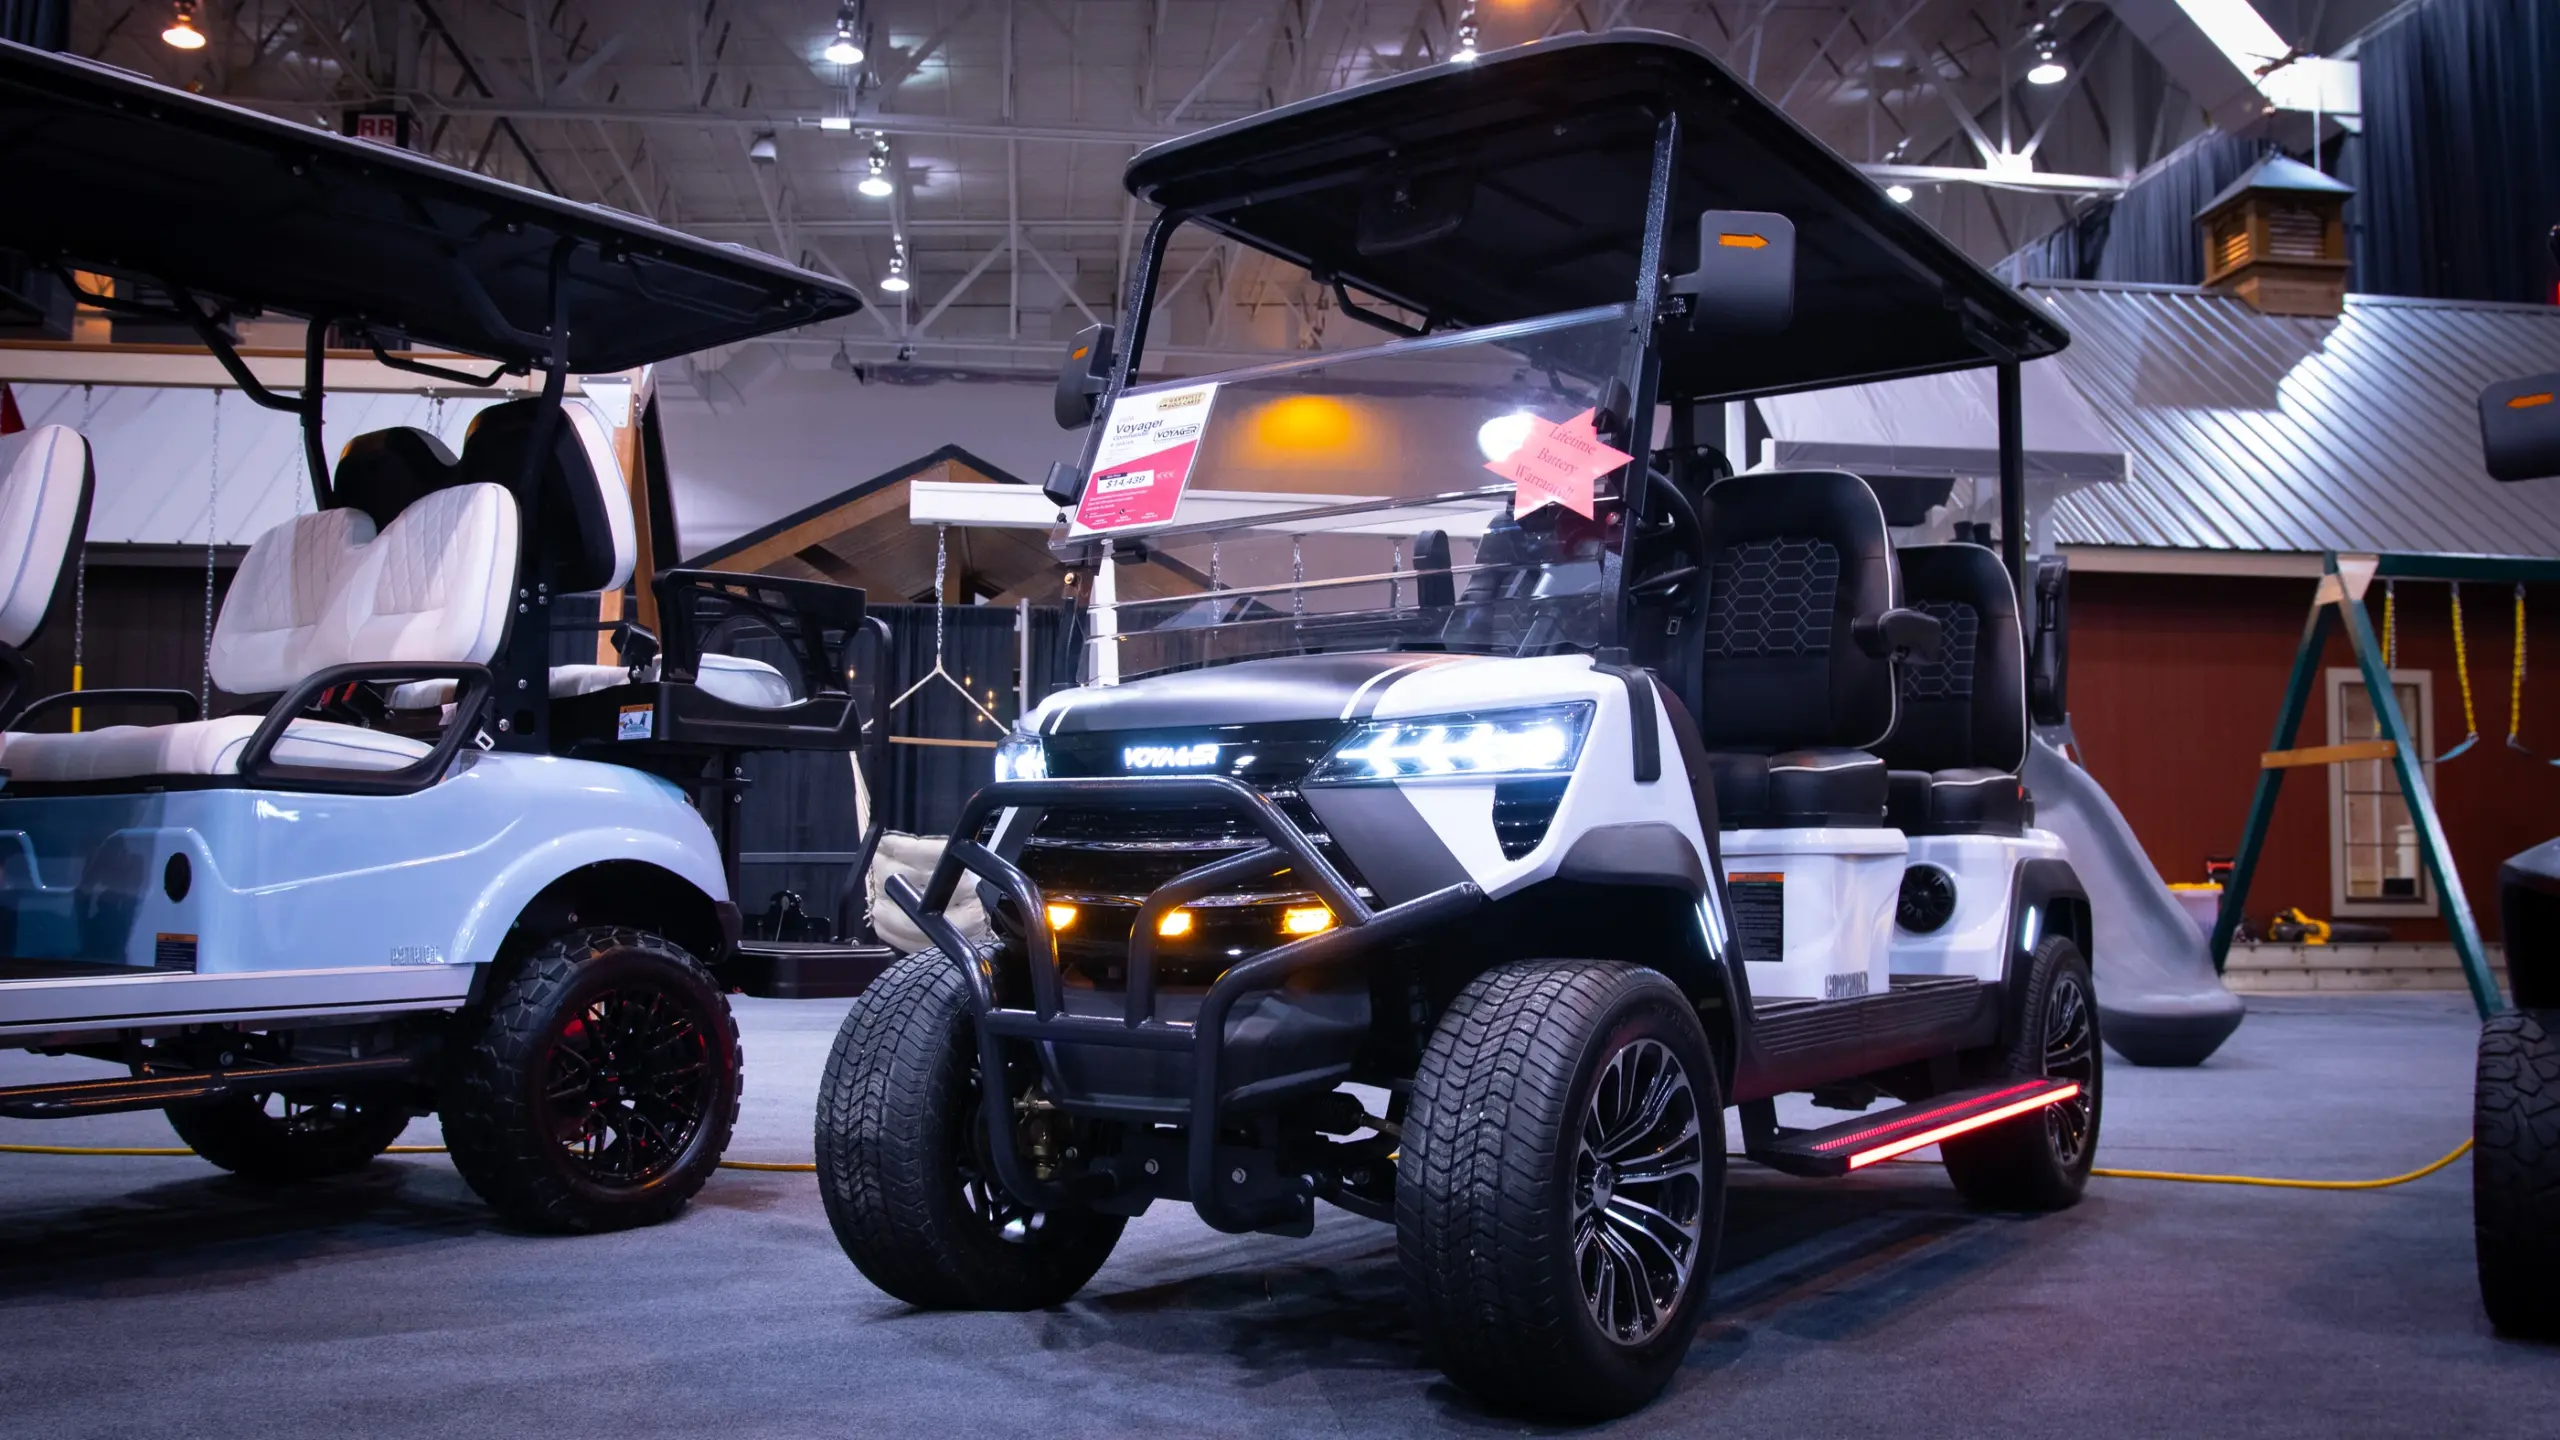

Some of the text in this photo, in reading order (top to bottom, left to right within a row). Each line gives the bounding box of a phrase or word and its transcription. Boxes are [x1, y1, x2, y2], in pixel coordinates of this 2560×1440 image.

[361, 118, 394, 136] RR
[1116, 419, 1164, 434] Voyager
[1157, 426, 1198, 438] VOYAGER
[1549, 426, 1597, 456] Lifetime
[1537, 448, 1578, 476] Battery
[1124, 744, 1219, 768] VOYAGER
